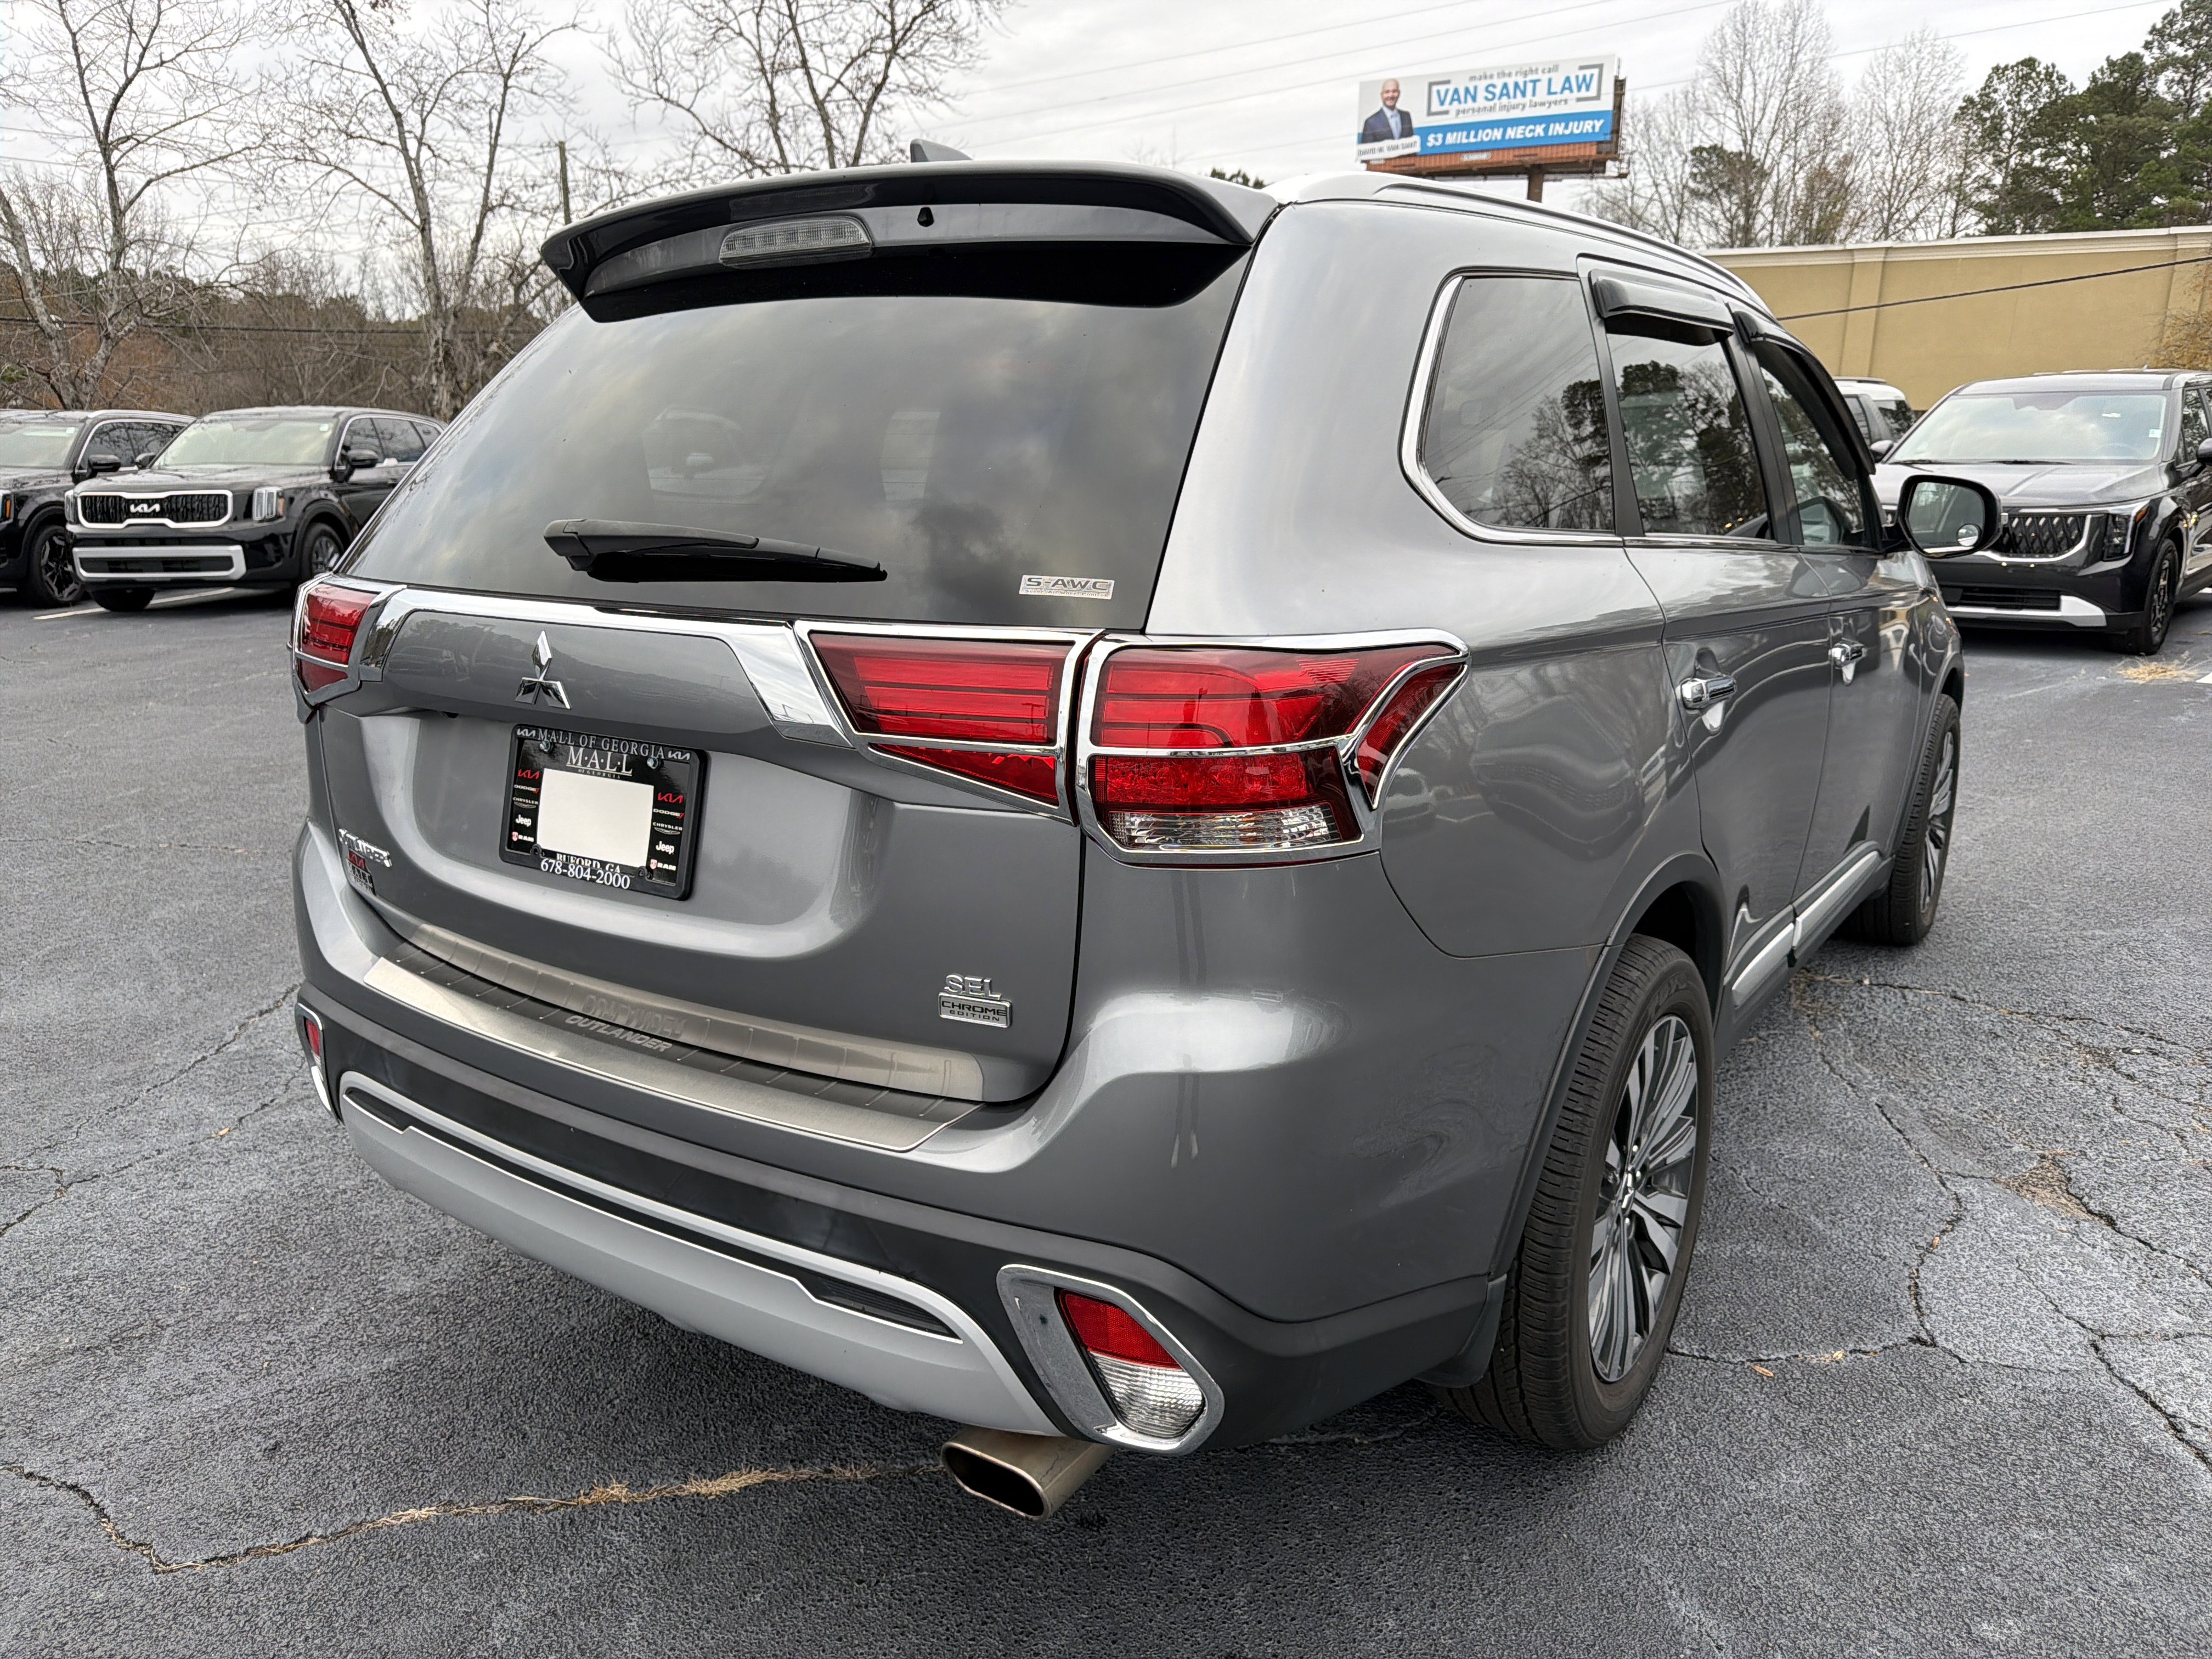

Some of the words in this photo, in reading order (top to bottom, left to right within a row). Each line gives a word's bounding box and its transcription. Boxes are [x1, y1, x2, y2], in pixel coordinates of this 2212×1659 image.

[1469, 72, 1494, 82] make
[1497, 69, 1512, 79] the
[1515, 65, 1539, 79] right
[1541, 64, 1559, 75] call
[1436, 84, 1478, 106] VAN
[1483, 78, 1542, 102] SANT
[1546, 73, 1594, 96] LAW
[1455, 103, 1497, 118] personal
[1499, 99, 1527, 113] injury
[1528, 96, 1569, 109] lawyers
[1426, 133, 1443, 147] $3
[1444, 128, 1504, 146] MILLION
[1505, 123, 1547, 140] NECK
[1548, 119, 1605, 137] INJURY
[130, 503, 160, 513] KIA
[1026, 577, 1108, 590] S-AWC
[517, 728, 536, 737] KIA
[579, 734, 597, 748] OF
[601, 738, 665, 759] GEORGIA
[668, 750, 690, 760] KIA
[518, 769, 540, 780] KIA
[513, 797, 538, 805] CHRYSLER
[658, 792, 684, 804] KIA
[653, 808, 680, 817] DODGE
[515, 814, 532, 827] Jeep
[652, 822, 683, 831] CHRYSLER
[656, 840, 675, 855] Jeep
[605, 863, 620, 873] GA
[657, 862, 676, 871] RAM
[540, 858, 630, 889] 678-804-2000
[944, 973, 1002, 1000] SEL
[941, 1000, 1007, 1017] CHROME
[949, 1009, 1000, 1022] EDITION
[565, 1015, 673, 1052] OUTLANDER
